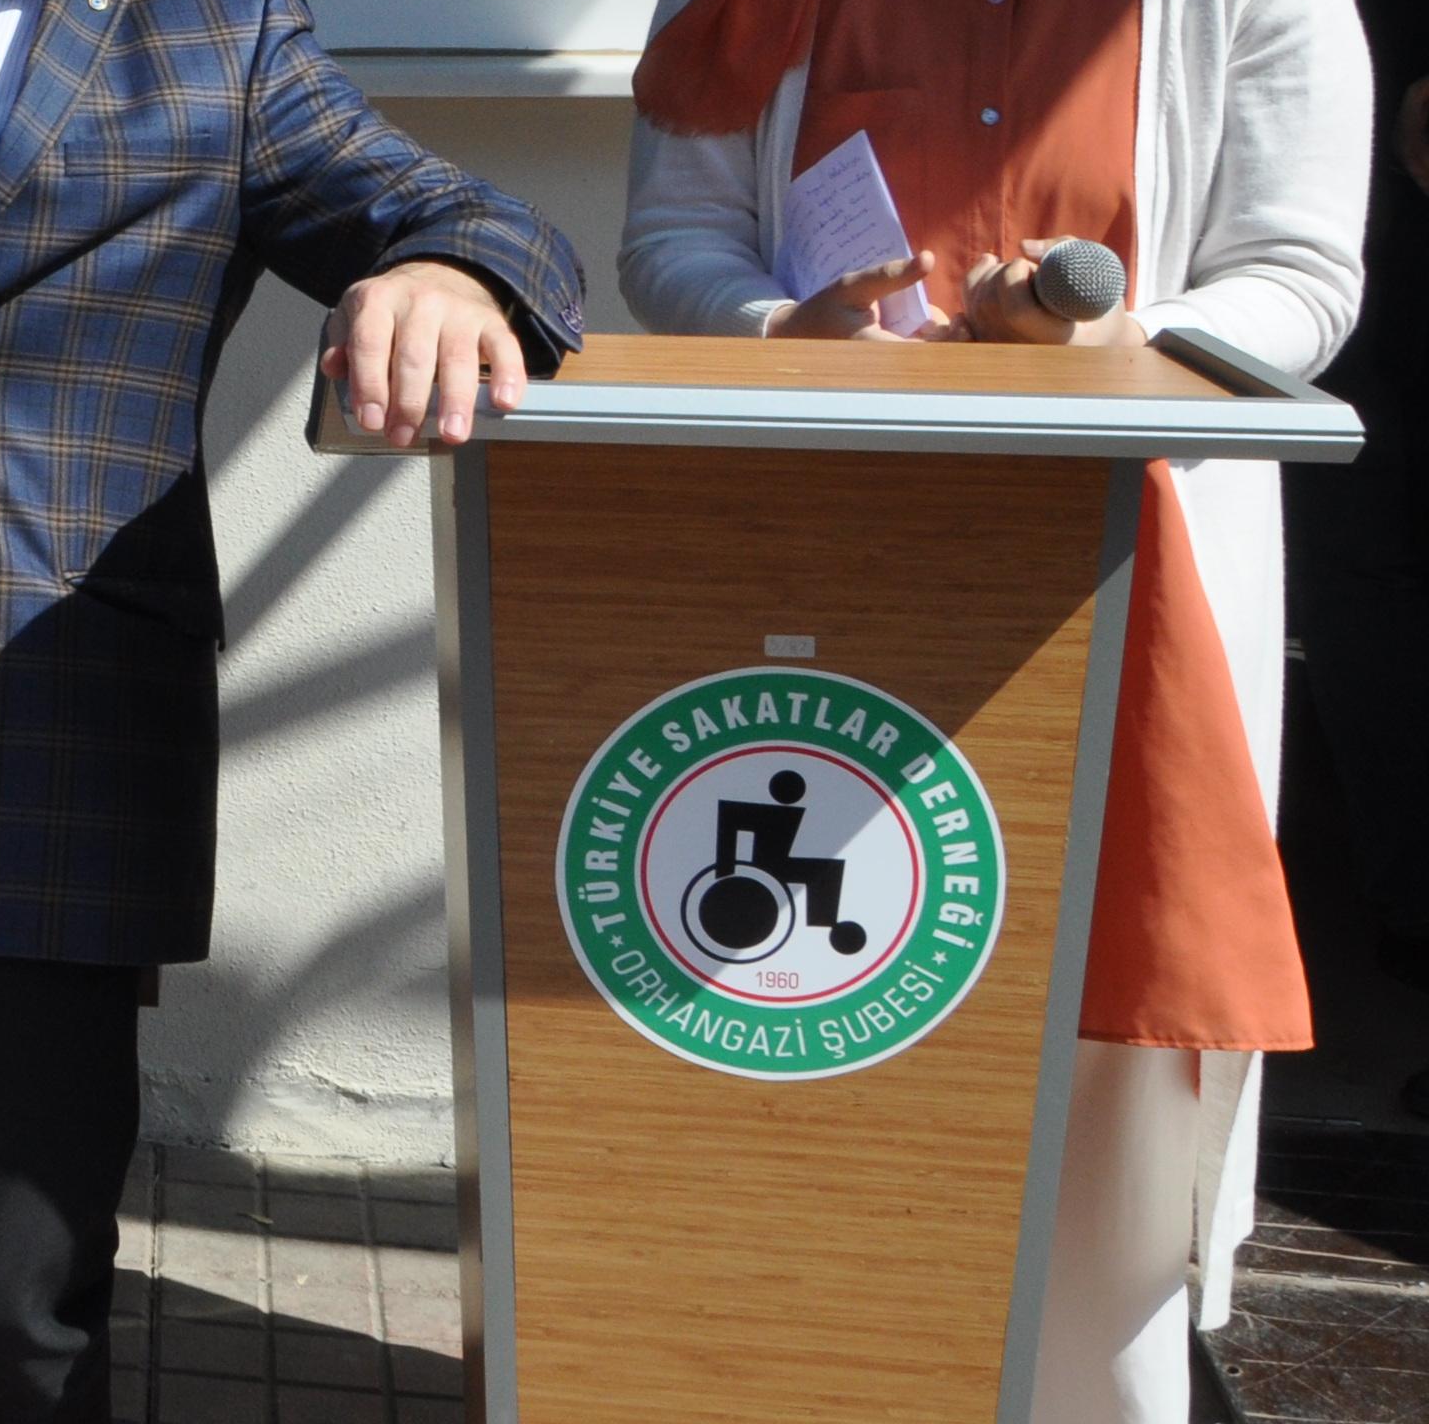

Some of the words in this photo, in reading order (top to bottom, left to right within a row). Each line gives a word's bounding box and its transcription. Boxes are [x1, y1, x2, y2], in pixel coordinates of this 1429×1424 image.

[579, 747, 662, 934] TÜRKİYE
[662, 691, 901, 758] SAKATLAR
[900, 752, 984, 950] DERNEĞİ
[610, 949, 807, 1058] ORHANGAZİ
[818, 960, 945, 1060] ŞUBESİ
[754, 971, 800, 990] 1960
